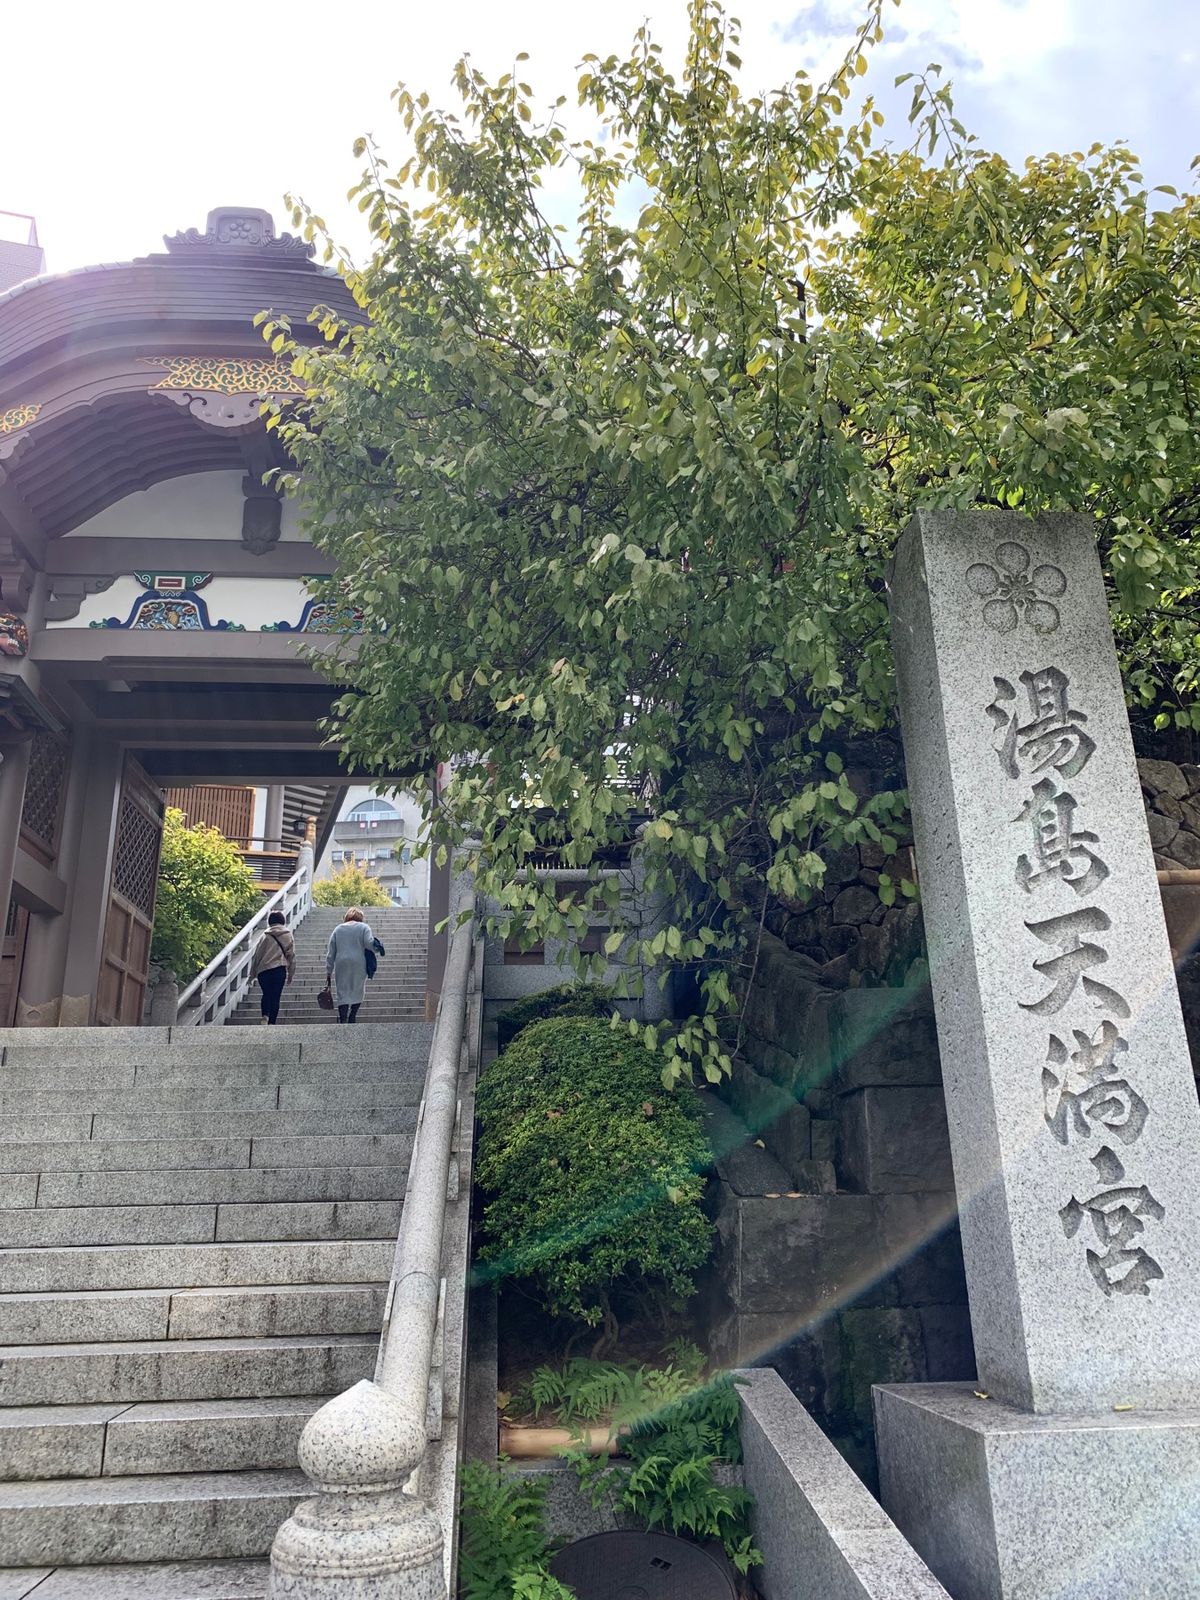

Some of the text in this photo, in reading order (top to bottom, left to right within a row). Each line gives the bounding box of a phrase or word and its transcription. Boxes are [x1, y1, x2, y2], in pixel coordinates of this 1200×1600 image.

[985, 665, 1166, 1297] 湯島天満宮
